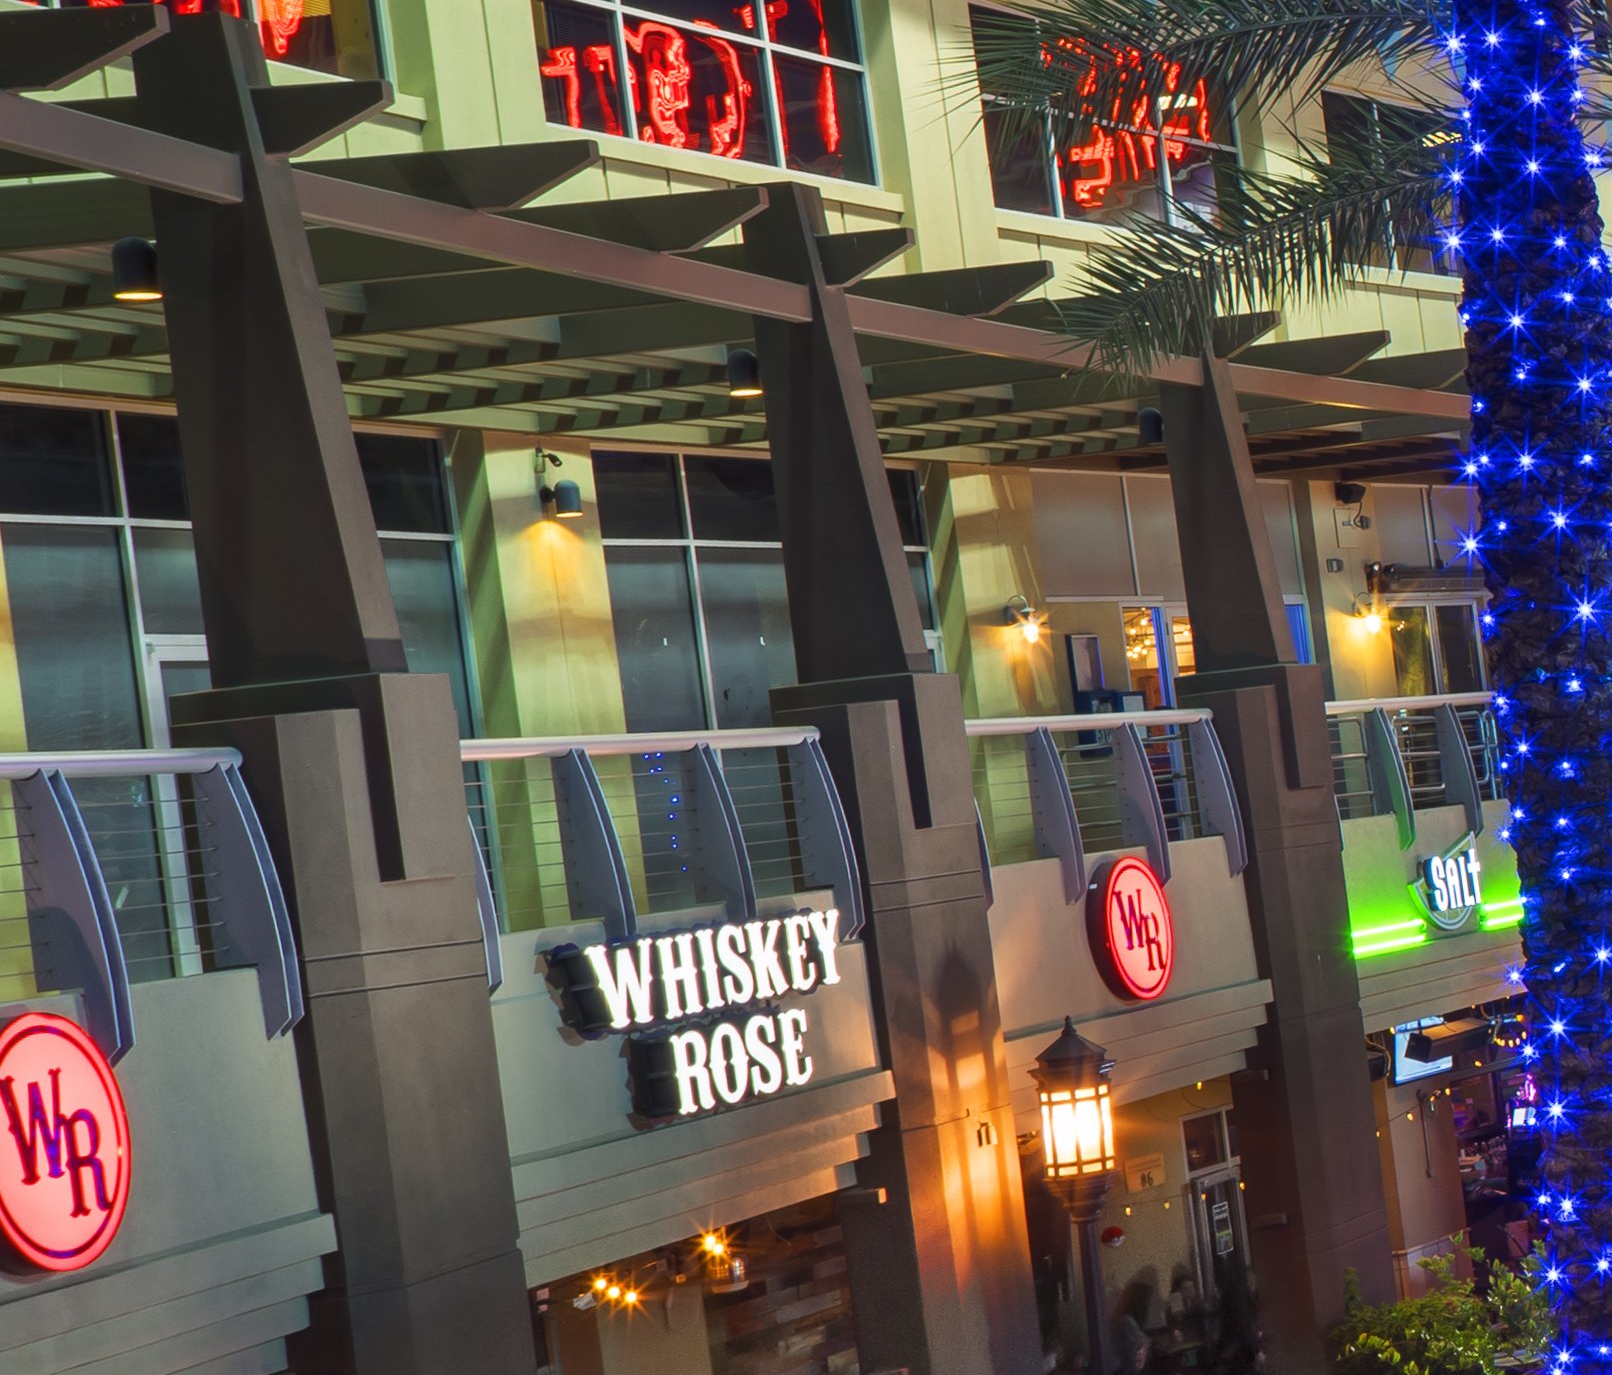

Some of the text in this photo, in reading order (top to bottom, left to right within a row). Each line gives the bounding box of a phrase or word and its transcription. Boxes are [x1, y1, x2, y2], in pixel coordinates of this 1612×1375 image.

[586, 908, 842, 1030] WHISKEY
[1113, 888, 1165, 974] WR
[669, 1009, 814, 1116] ROSE
[0, 1066, 113, 1220] WR
